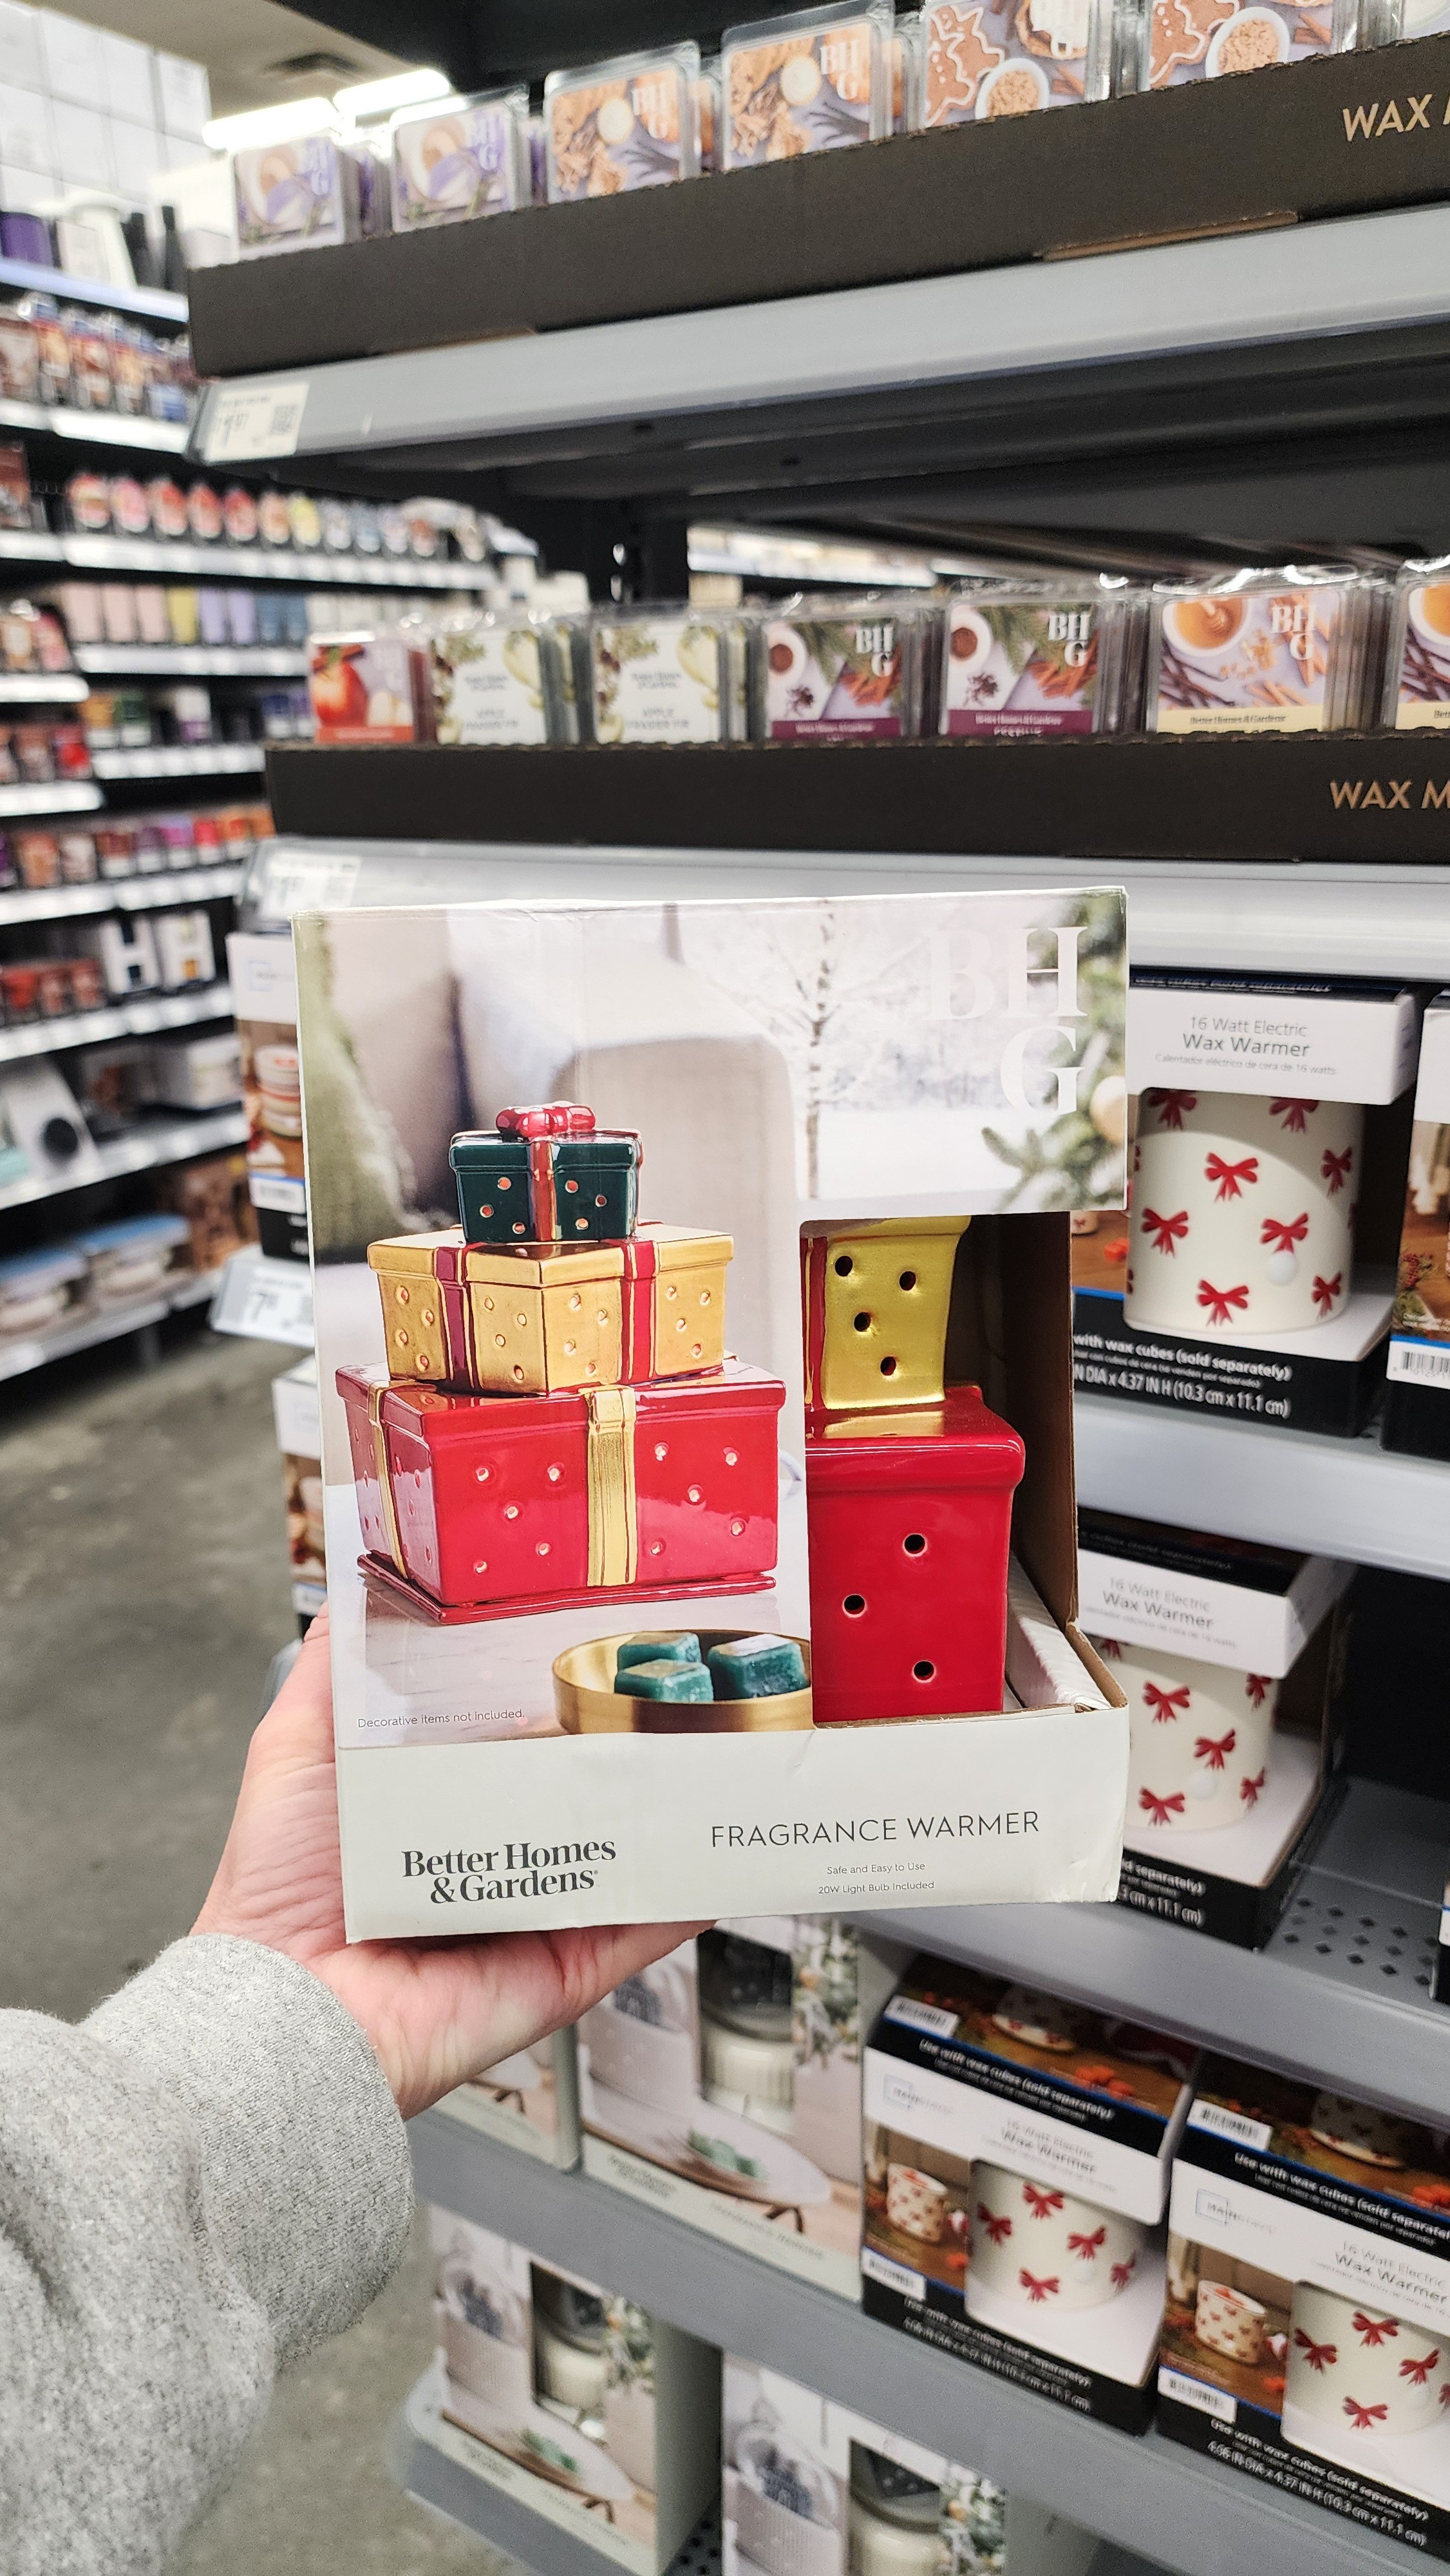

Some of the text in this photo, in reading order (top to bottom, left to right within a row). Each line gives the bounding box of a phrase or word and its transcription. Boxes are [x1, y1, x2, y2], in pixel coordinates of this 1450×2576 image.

[1342, 93, 1433, 142] WAX
[1048, 612, 1091, 641] BH
[1270, 604, 1318, 634] BH
[856, 625, 894, 654] BH
[1064, 640, 1089, 667] G
[1290, 633, 1313, 660] G
[872, 653, 894, 677] G
[1330, 779, 1412, 809] WAX
[925, 926, 1088, 1019] BH
[1191, 1016, 1308, 1037] 16 Watt Electric
[1183, 1033, 1312, 1057] Wax Warmer
[1001, 1025, 1086, 1116] G
[1074, 1334, 1293, 1383] with wax cubes (sold separately)
[1086, 1365, 1108, 1385] DIA
[1108, 1372, 1117, 1387] x
[1117, 1370, 1145, 1392] 4.37
[1145, 1377, 1160, 1395] IN
[1160, 1379, 1172, 1397] H
[1173, 1380, 1205, 1401] (10.3
[1205, 1390, 1225, 1406] cm
[1225, 1392, 1236, 1408] x
[1236, 1390, 1264, 1413] 11.1
[1265, 1397, 1291, 1419] cm)
[1103, 1591, 1139, 1611] Wax
[1144, 1600, 1214, 1630] Warmer
[1128, 1582, 1161, 1598] Watt
[1164, 1589, 1211, 1612] Electric
[358, 1709, 525, 1728] Decorative items not included.
[712, 1810, 1039, 1848] FRAGRANCE WARMER
[401, 1841, 616, 1877] Better Homes
[827, 1862, 926, 1875] Safe and Easy to Use
[818, 1881, 934, 1895] 20W Light Bulb Included
[1135, 1864, 1207, 1897] separately)
[1235, 2152, 1258, 2170] Use
[1259, 2161, 1289, 2181] with
[1290, 2174, 1319, 2192] wax
[1318, 2185, 1357, 2206] cubes
[1357, 2197, 1391, 2220] (sold
[1335, 2251, 1372, 2275] Wax
[1379, 2268, 1448, 2304] Warmer
[1362, 2248, 1393, 2268] Watt
[1398, 2262, 1445, 2287] Electric
[1234, 2430, 1263, 2449] with
[1263, 2443, 1290, 2461] wax
[1290, 2456, 1326, 2477] cubes
[1327, 2470, 1359, 2491] (sold
[1359, 2486, 1429, 2521] separately)
